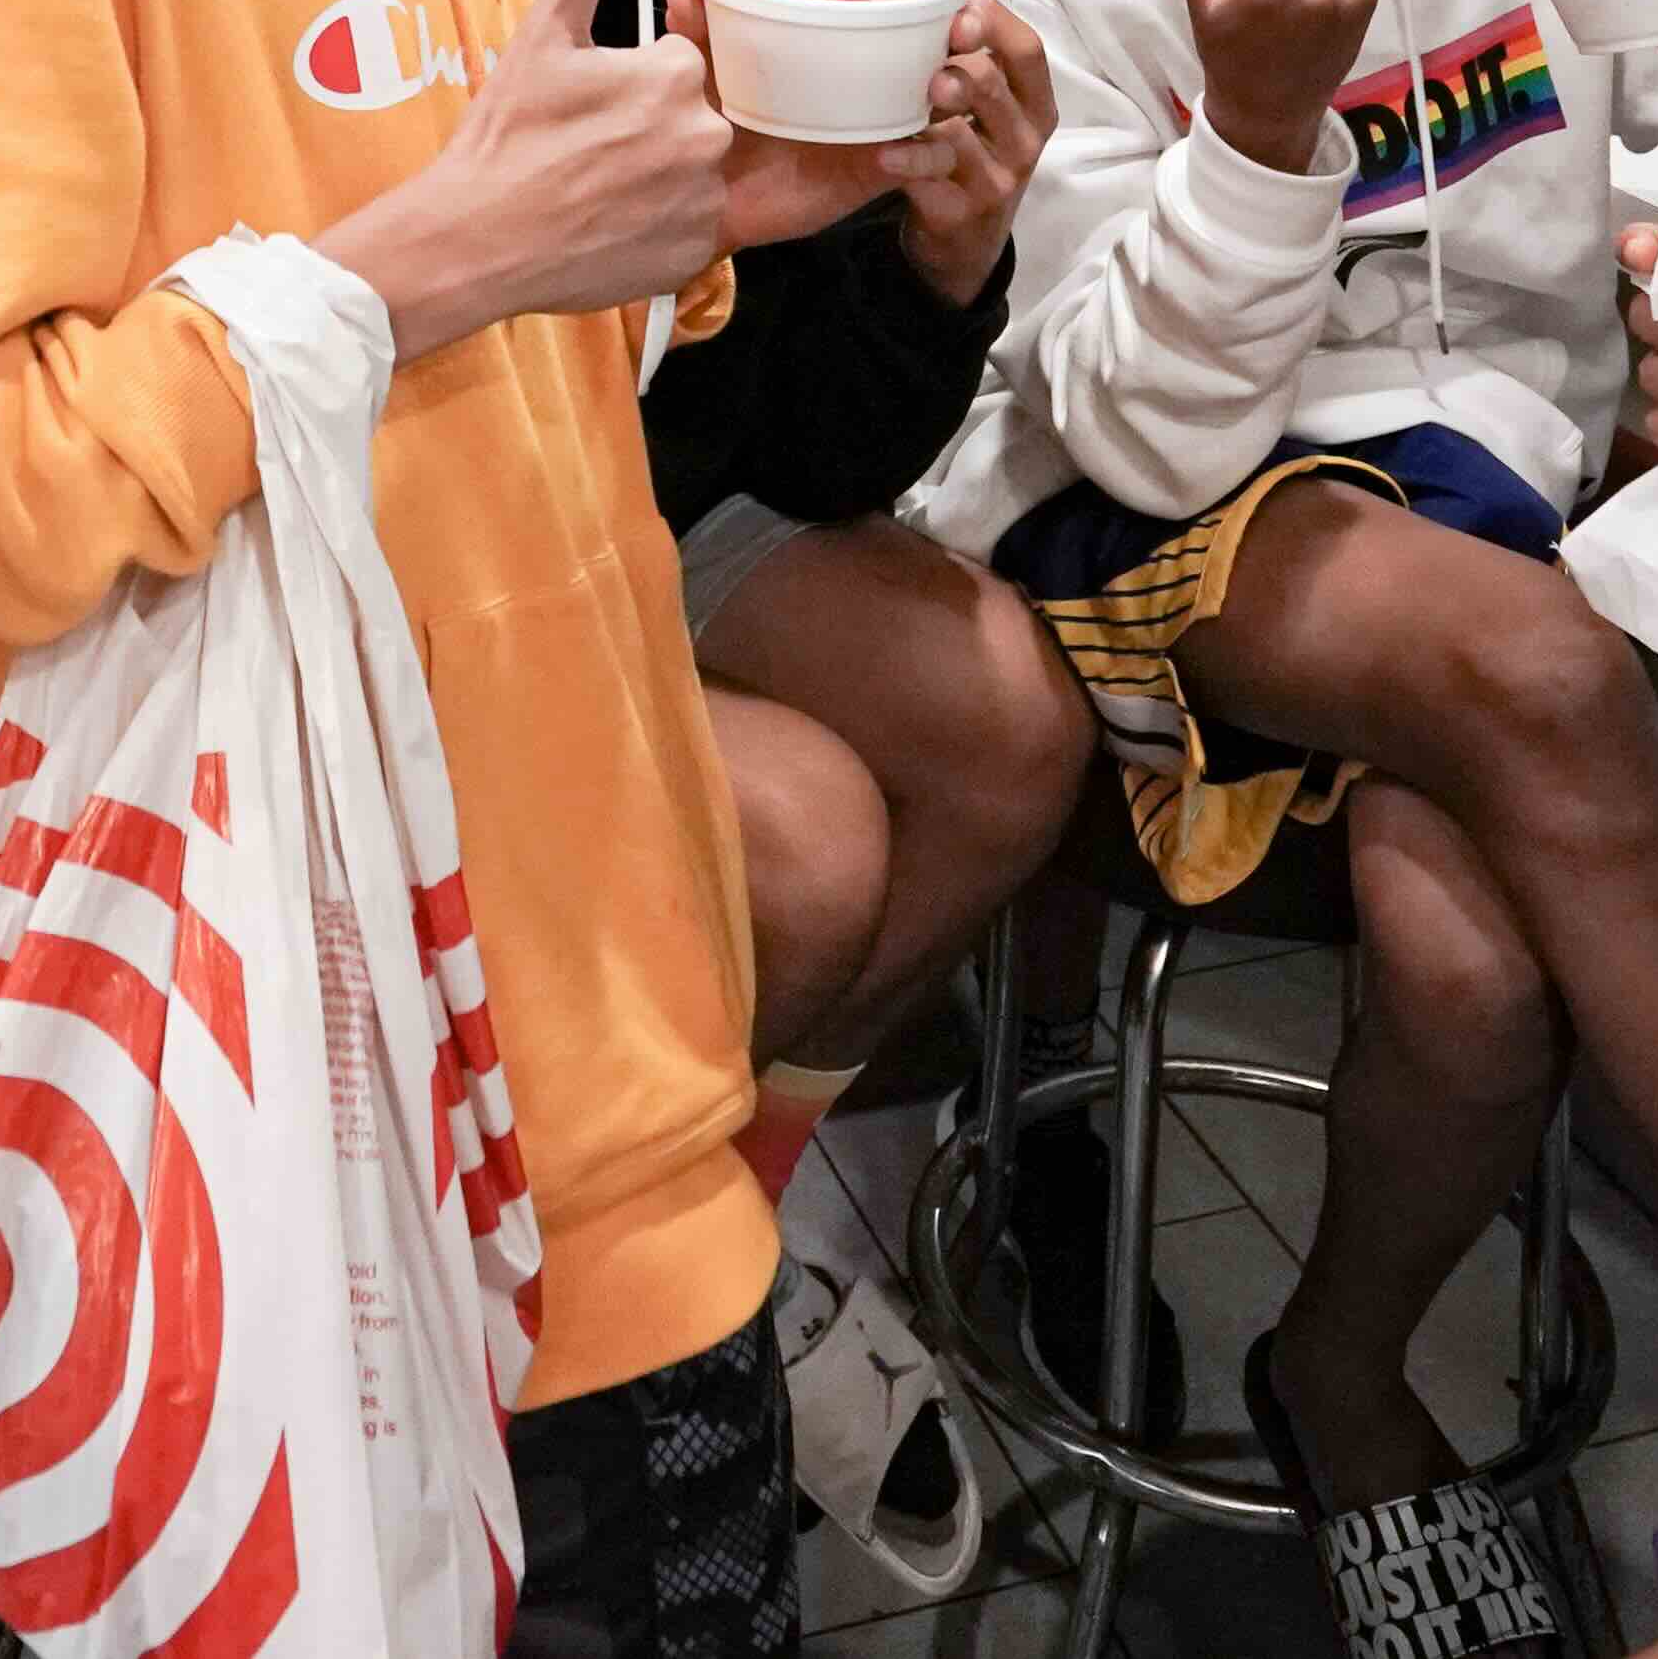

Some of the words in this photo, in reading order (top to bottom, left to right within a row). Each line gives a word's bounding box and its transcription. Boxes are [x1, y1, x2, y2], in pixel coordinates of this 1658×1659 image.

[1343, 78, 1460, 182] DO
[1460, 42, 1531, 130] IT.
[1432, 1480, 1501, 1540] JUS
[1338, 1544, 1441, 1636] JUST
[1438, 1528, 1514, 1602] DO
